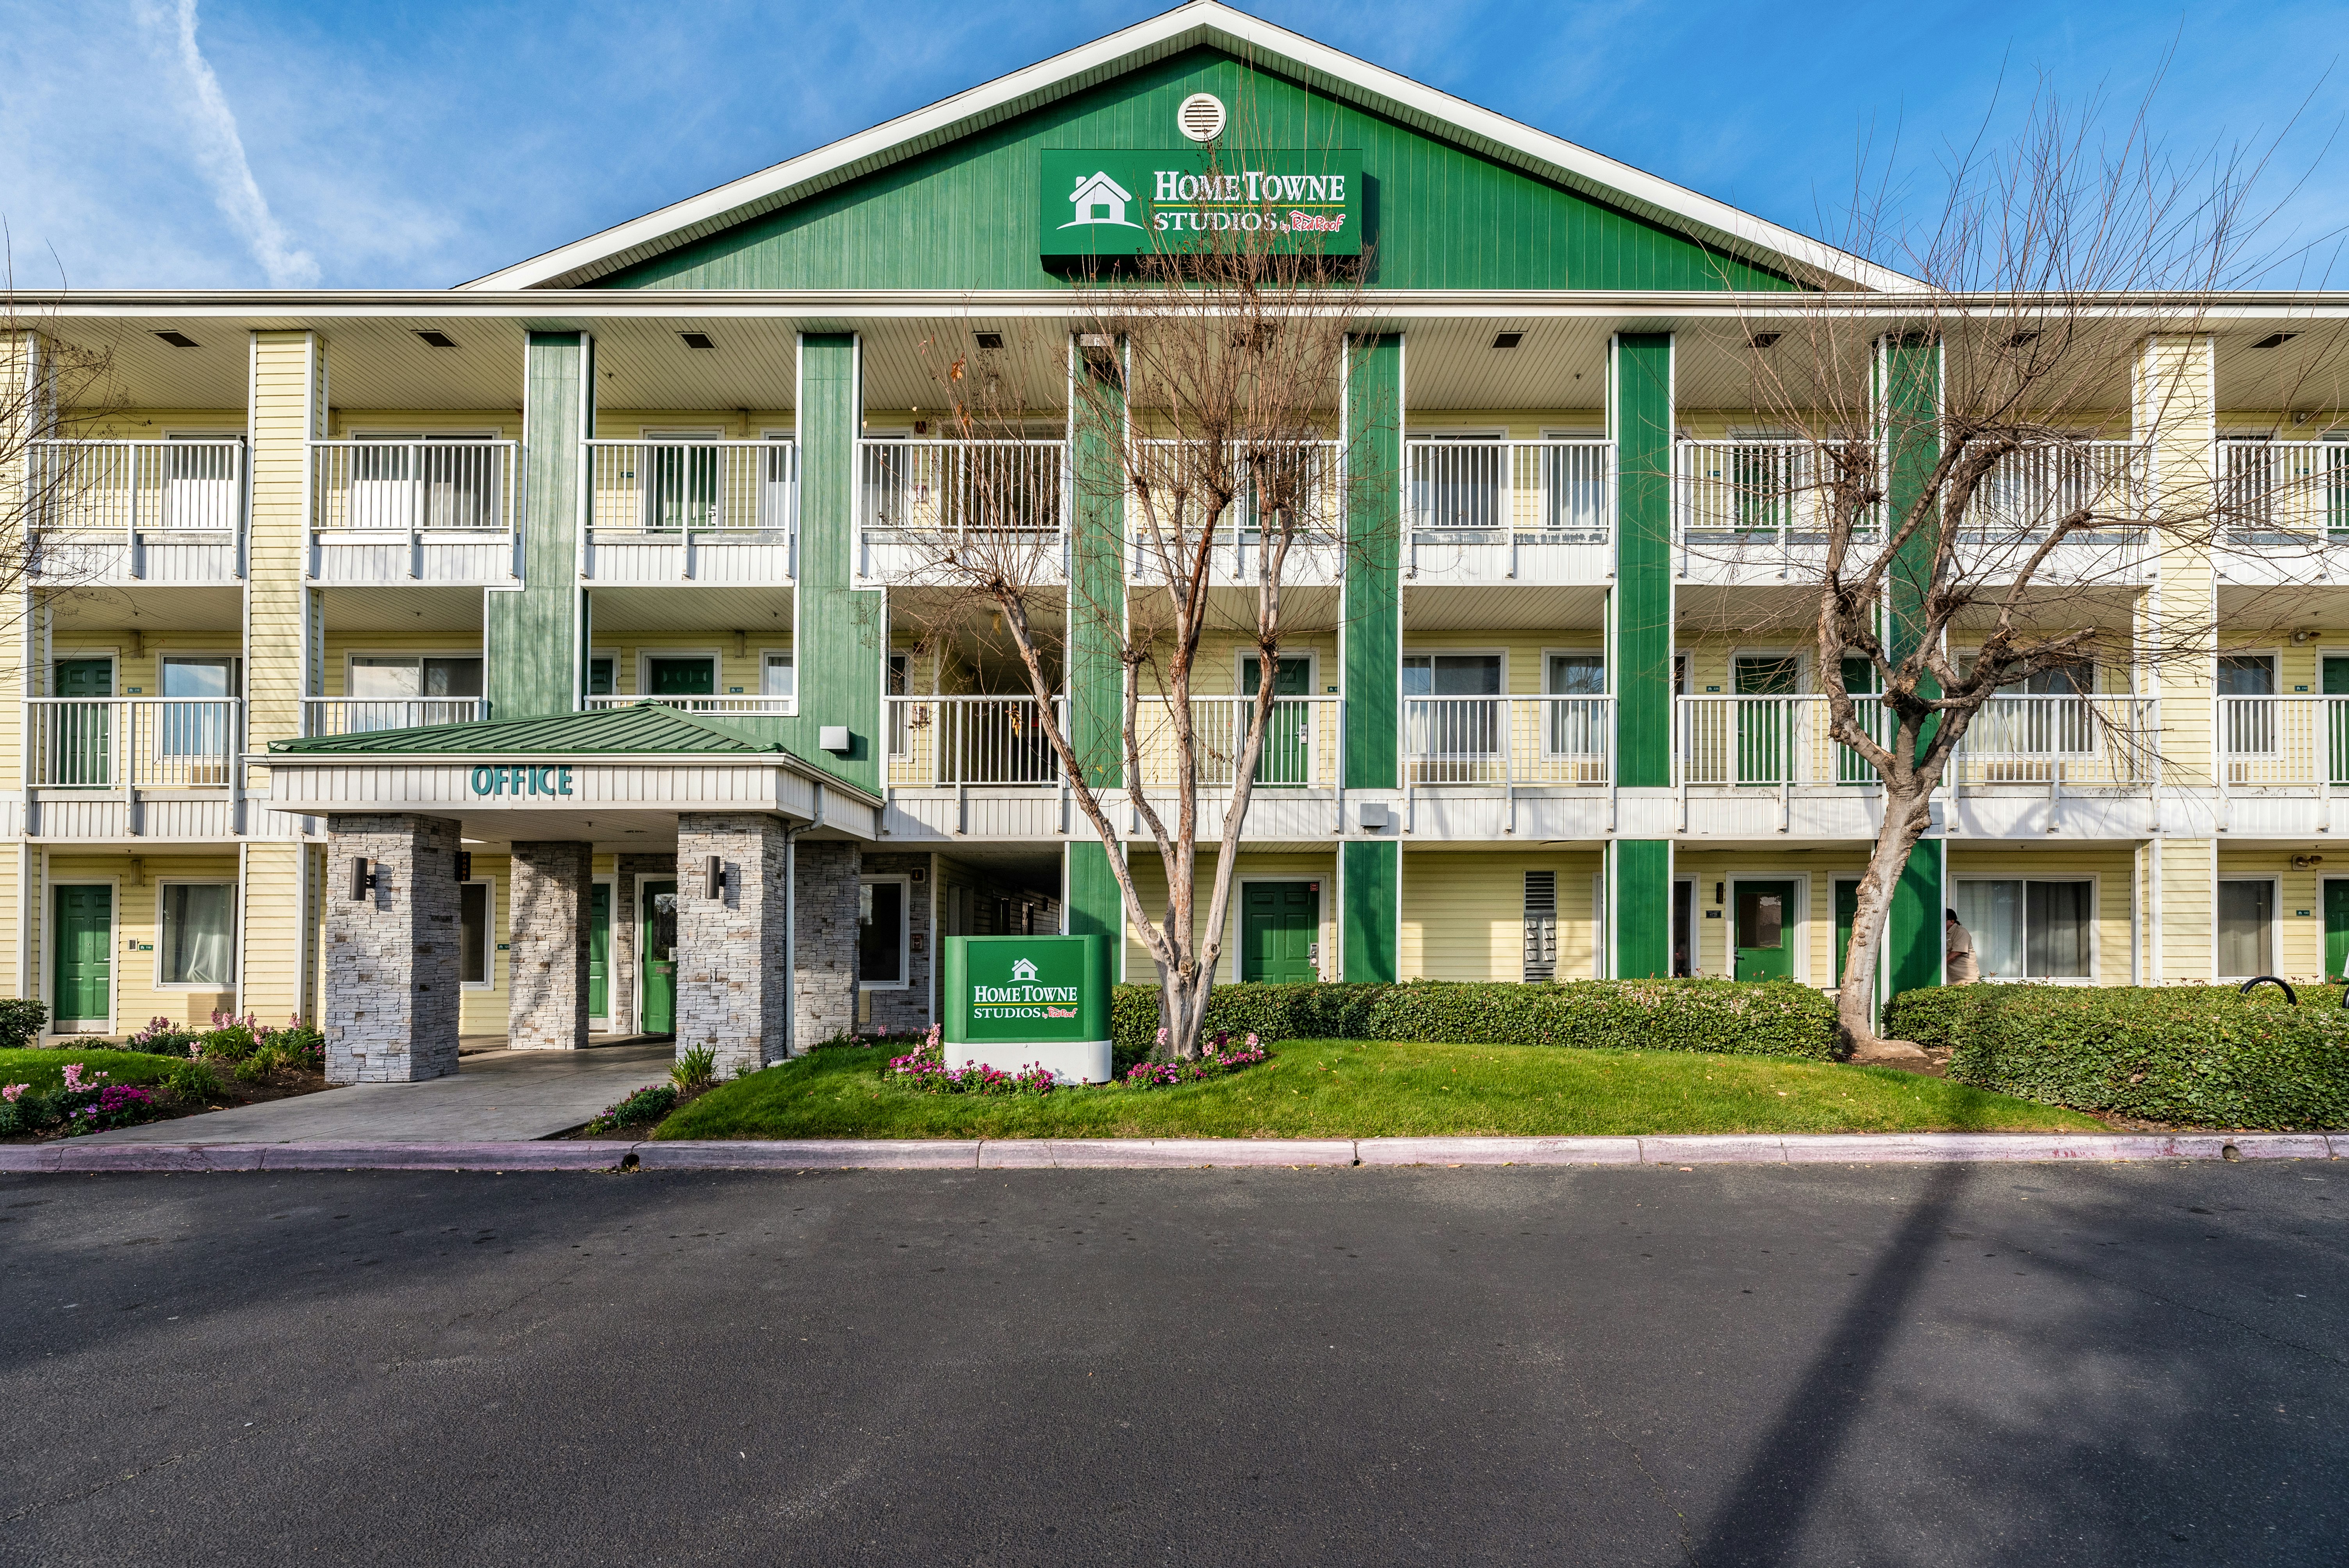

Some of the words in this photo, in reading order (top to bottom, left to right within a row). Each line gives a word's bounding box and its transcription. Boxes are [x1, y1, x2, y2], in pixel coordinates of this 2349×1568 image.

[1154, 212, 1277, 231] STUDIOS
[1280, 220, 1290, 233] by
[471, 764, 572, 795] OFFICE
[974, 985, 1077, 1002] HOMETOWNE
[974, 1007, 1041, 1018] STUDIOS
